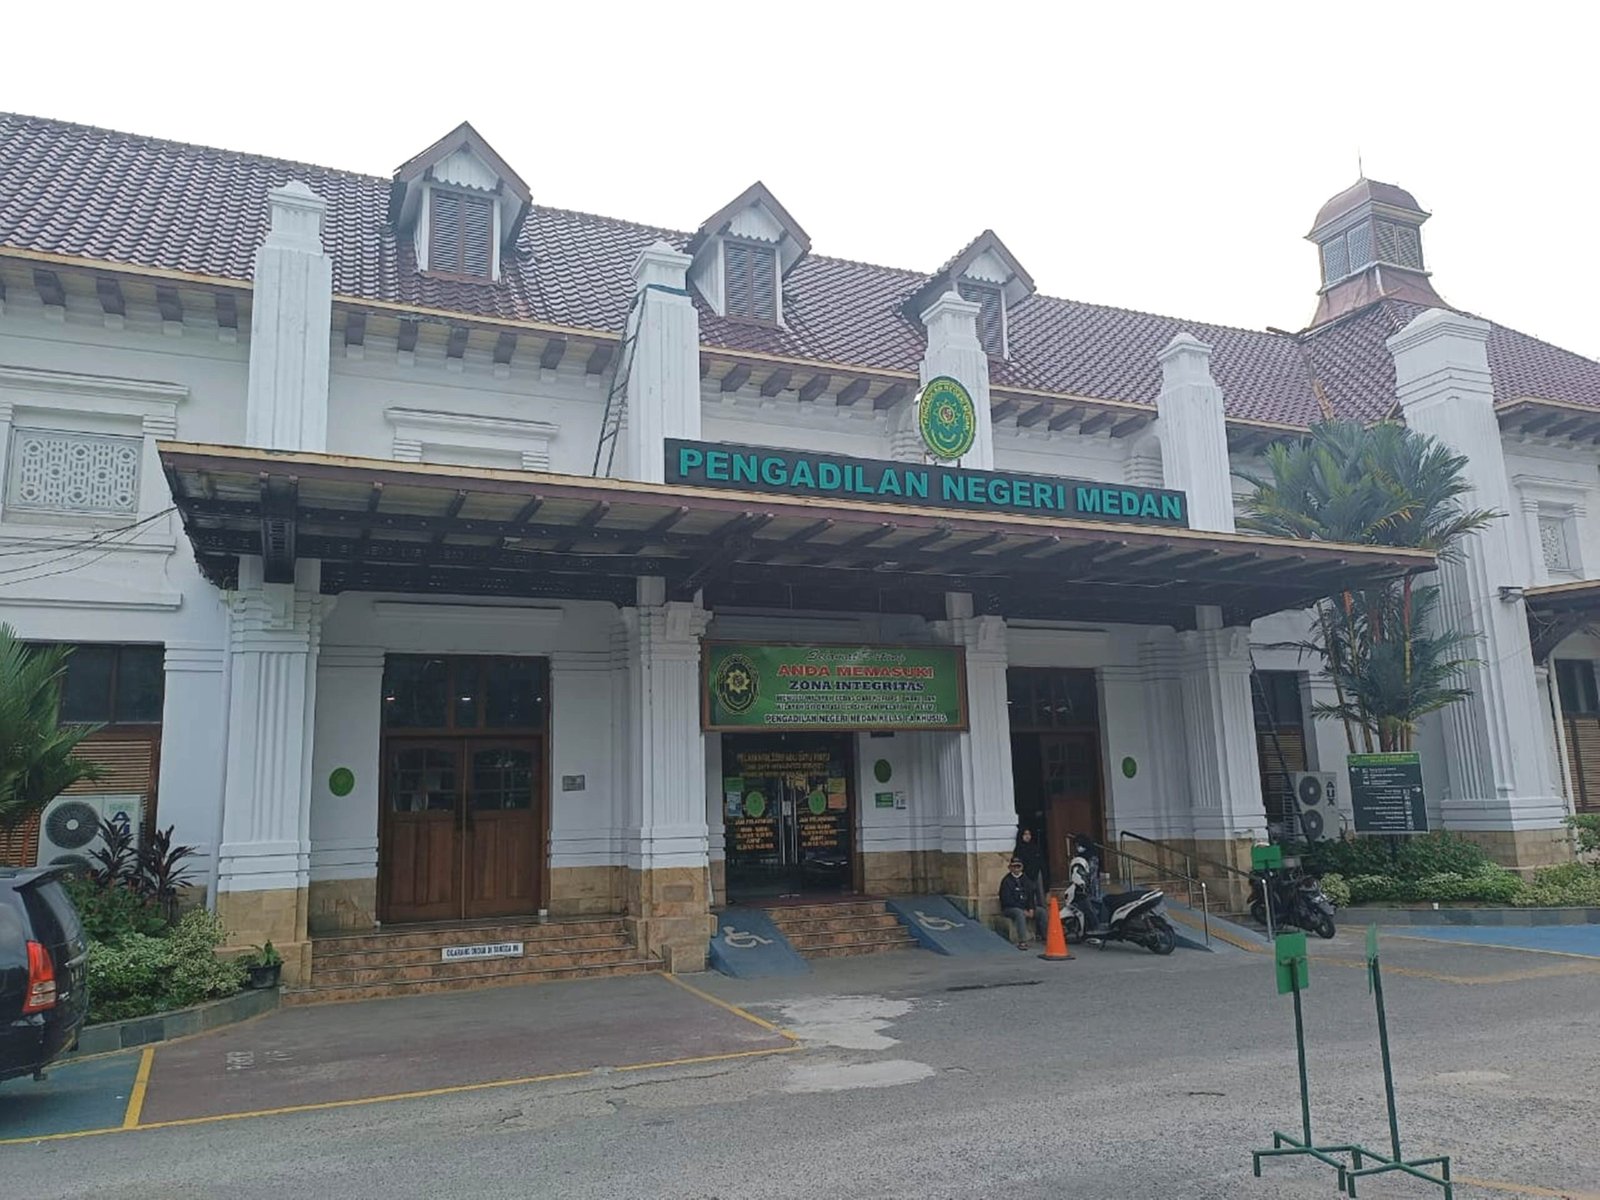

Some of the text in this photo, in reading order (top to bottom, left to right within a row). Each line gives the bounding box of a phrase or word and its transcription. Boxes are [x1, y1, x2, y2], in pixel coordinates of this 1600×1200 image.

[678, 447, 1182, 520] PENGADILAN NEGERI MEDAN
[777, 664, 831, 678] ANDA
[835, 665, 934, 680] MEMASUKI
[788, 680, 925, 692] ZONA INTEGRITAS
[764, 713, 818, 724] PENGADILAN
[819, 714, 848, 724] NEGERI
[850, 714, 878, 724] MEDAN
[1326, 781, 1335, 807] AUX
